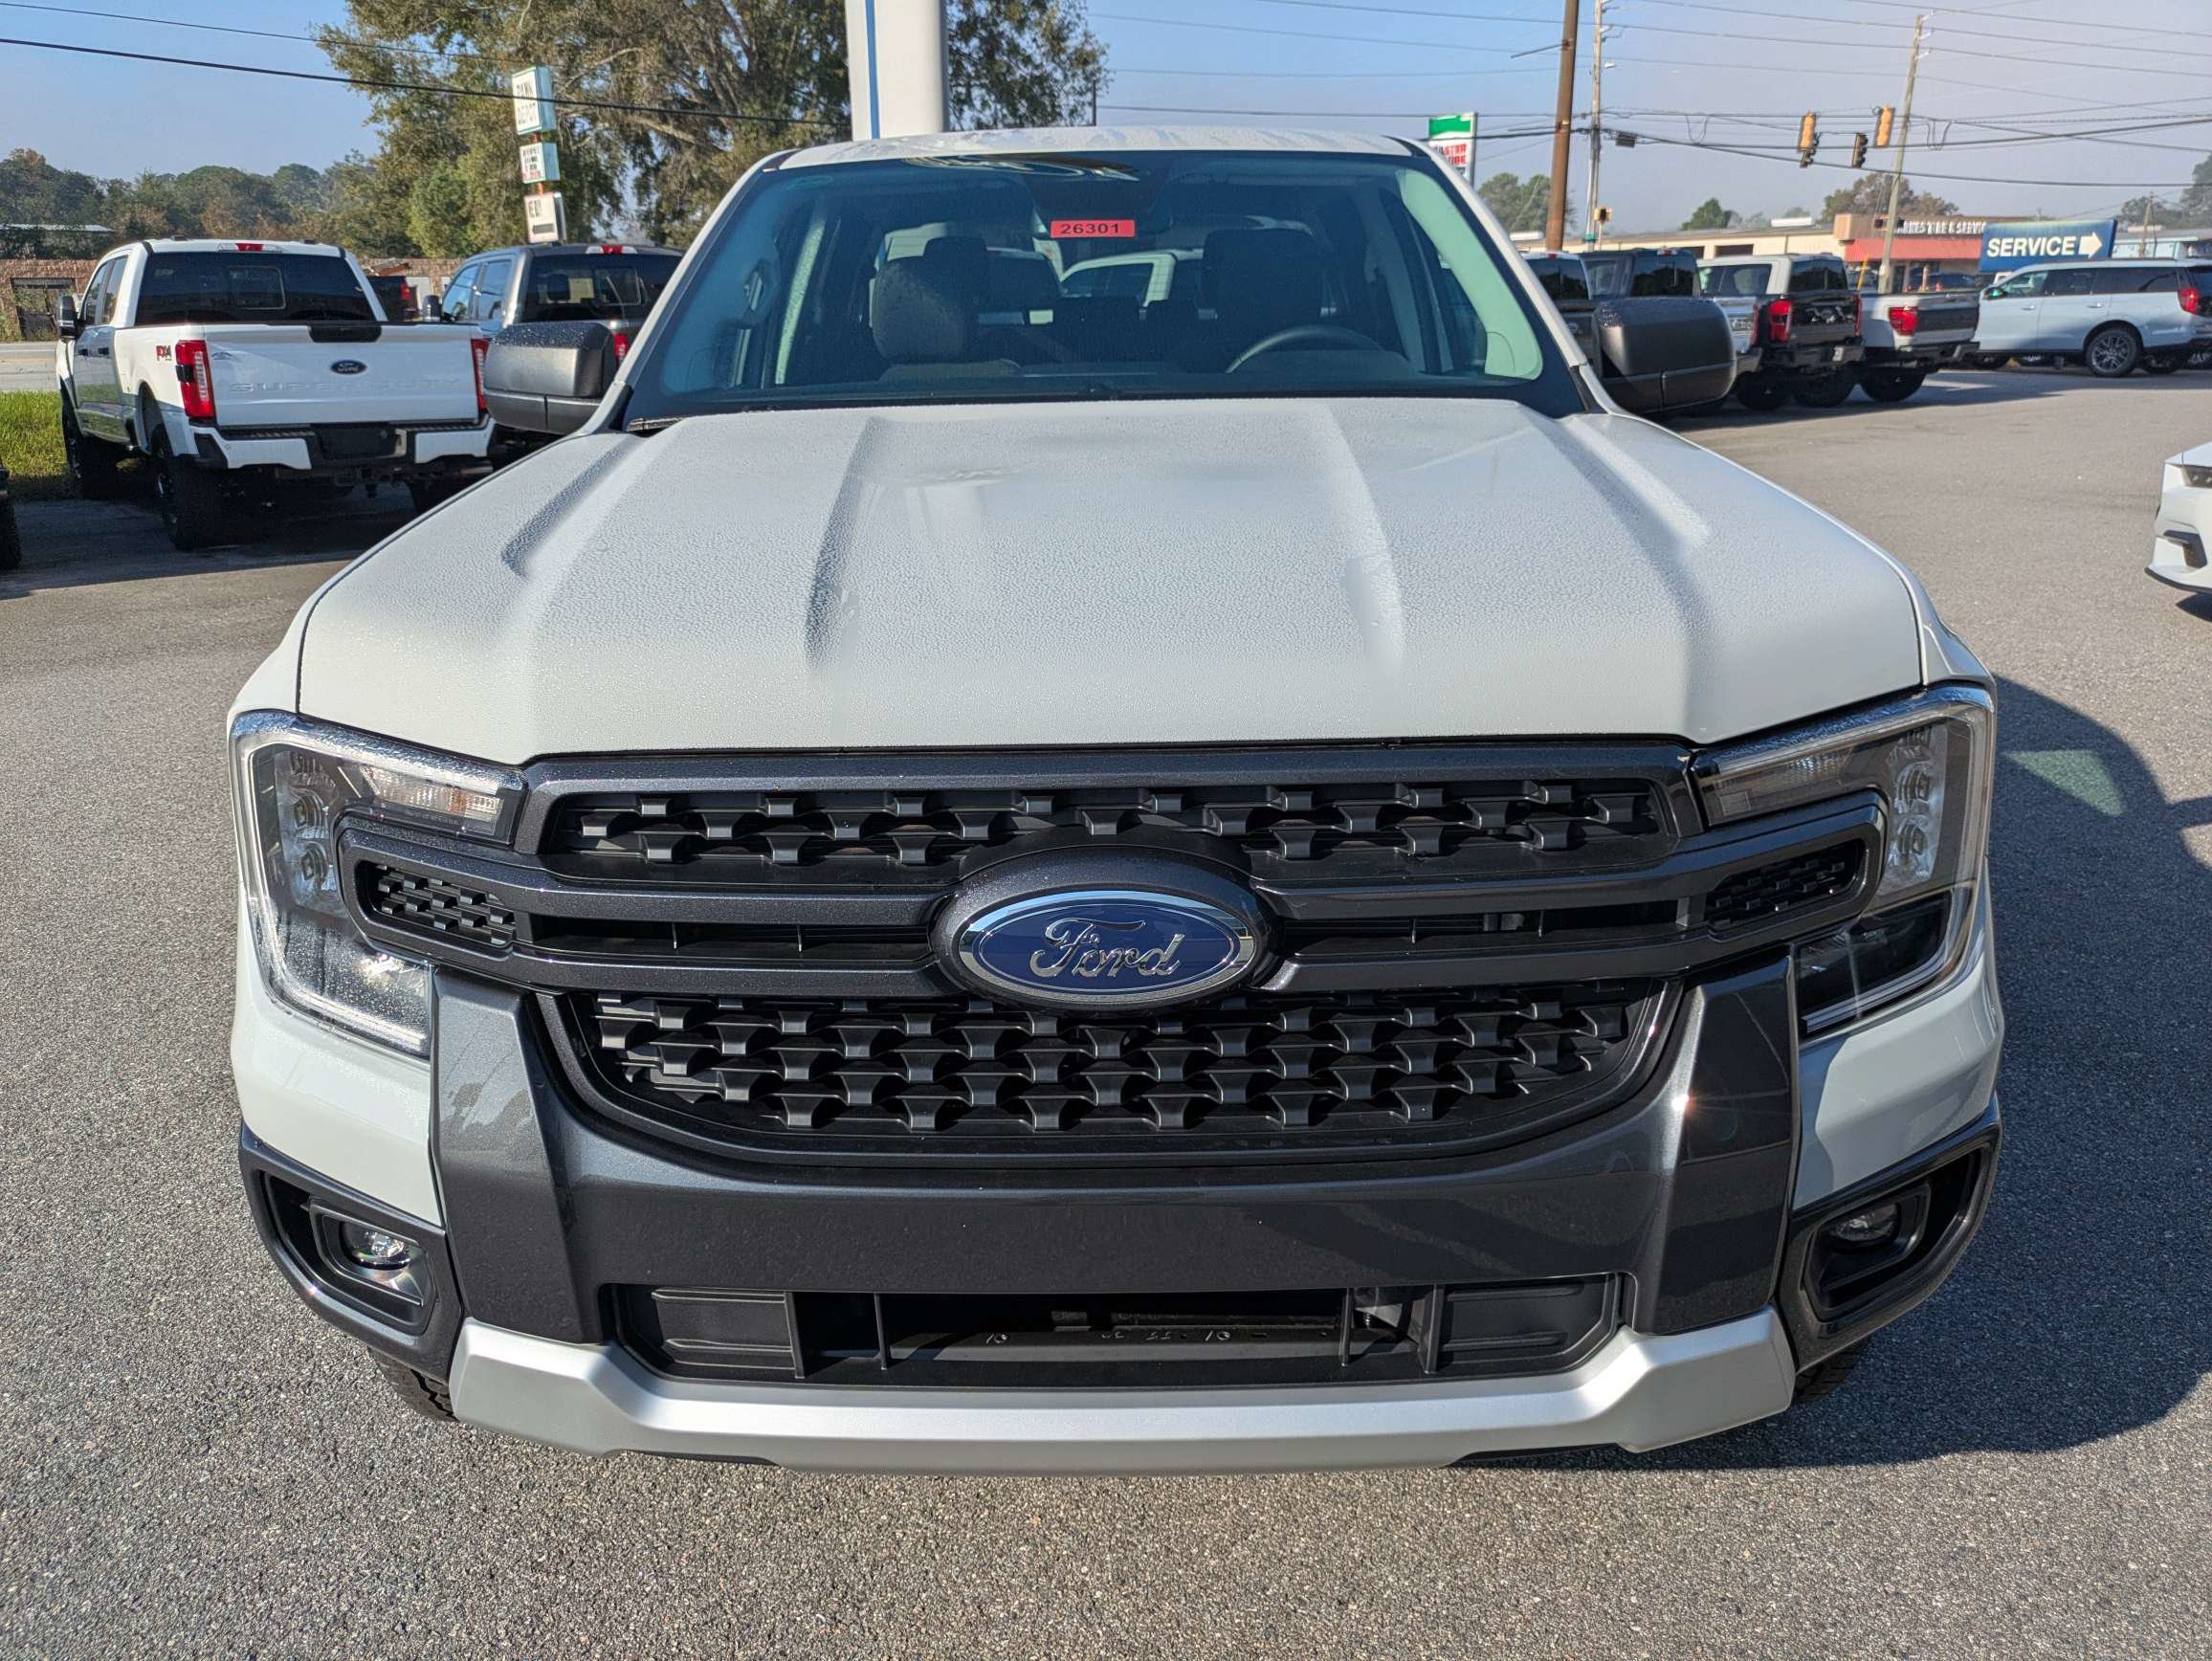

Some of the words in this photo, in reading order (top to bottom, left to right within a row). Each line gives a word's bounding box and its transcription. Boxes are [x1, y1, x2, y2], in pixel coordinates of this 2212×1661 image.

[1060, 223, 1118, 234] 26301
[1956, 220, 1987, 234] SERVIC
[1986, 235, 2077, 257] SERVICE
[1029, 918, 1186, 978] Ford
